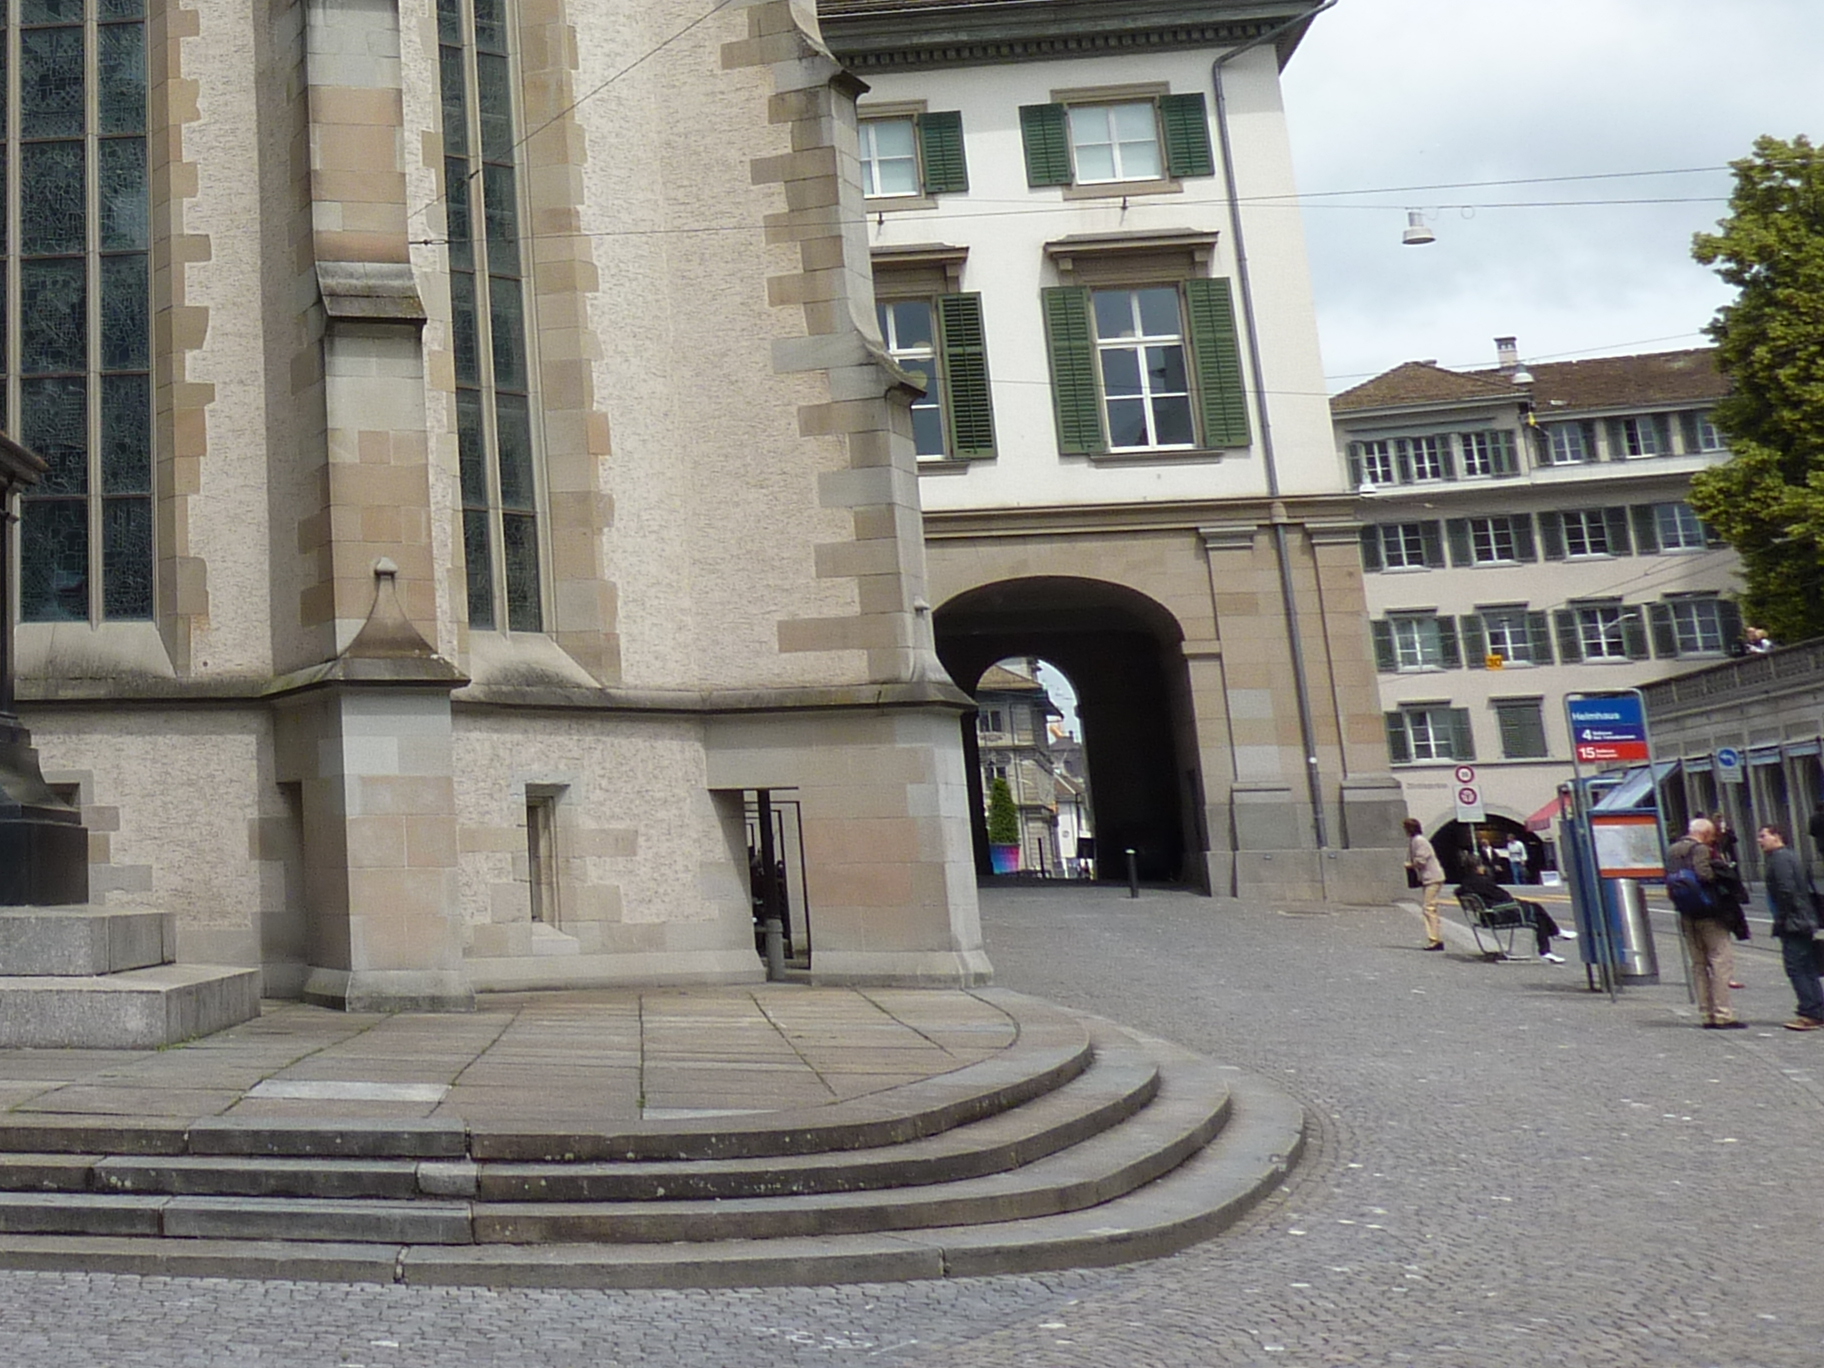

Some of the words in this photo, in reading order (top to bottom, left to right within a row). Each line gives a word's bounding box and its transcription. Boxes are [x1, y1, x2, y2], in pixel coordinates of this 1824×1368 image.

[1572, 712, 1621, 721] Helmhaus
[1581, 729, 1593, 741] 4
[1578, 747, 1596, 759] 15
